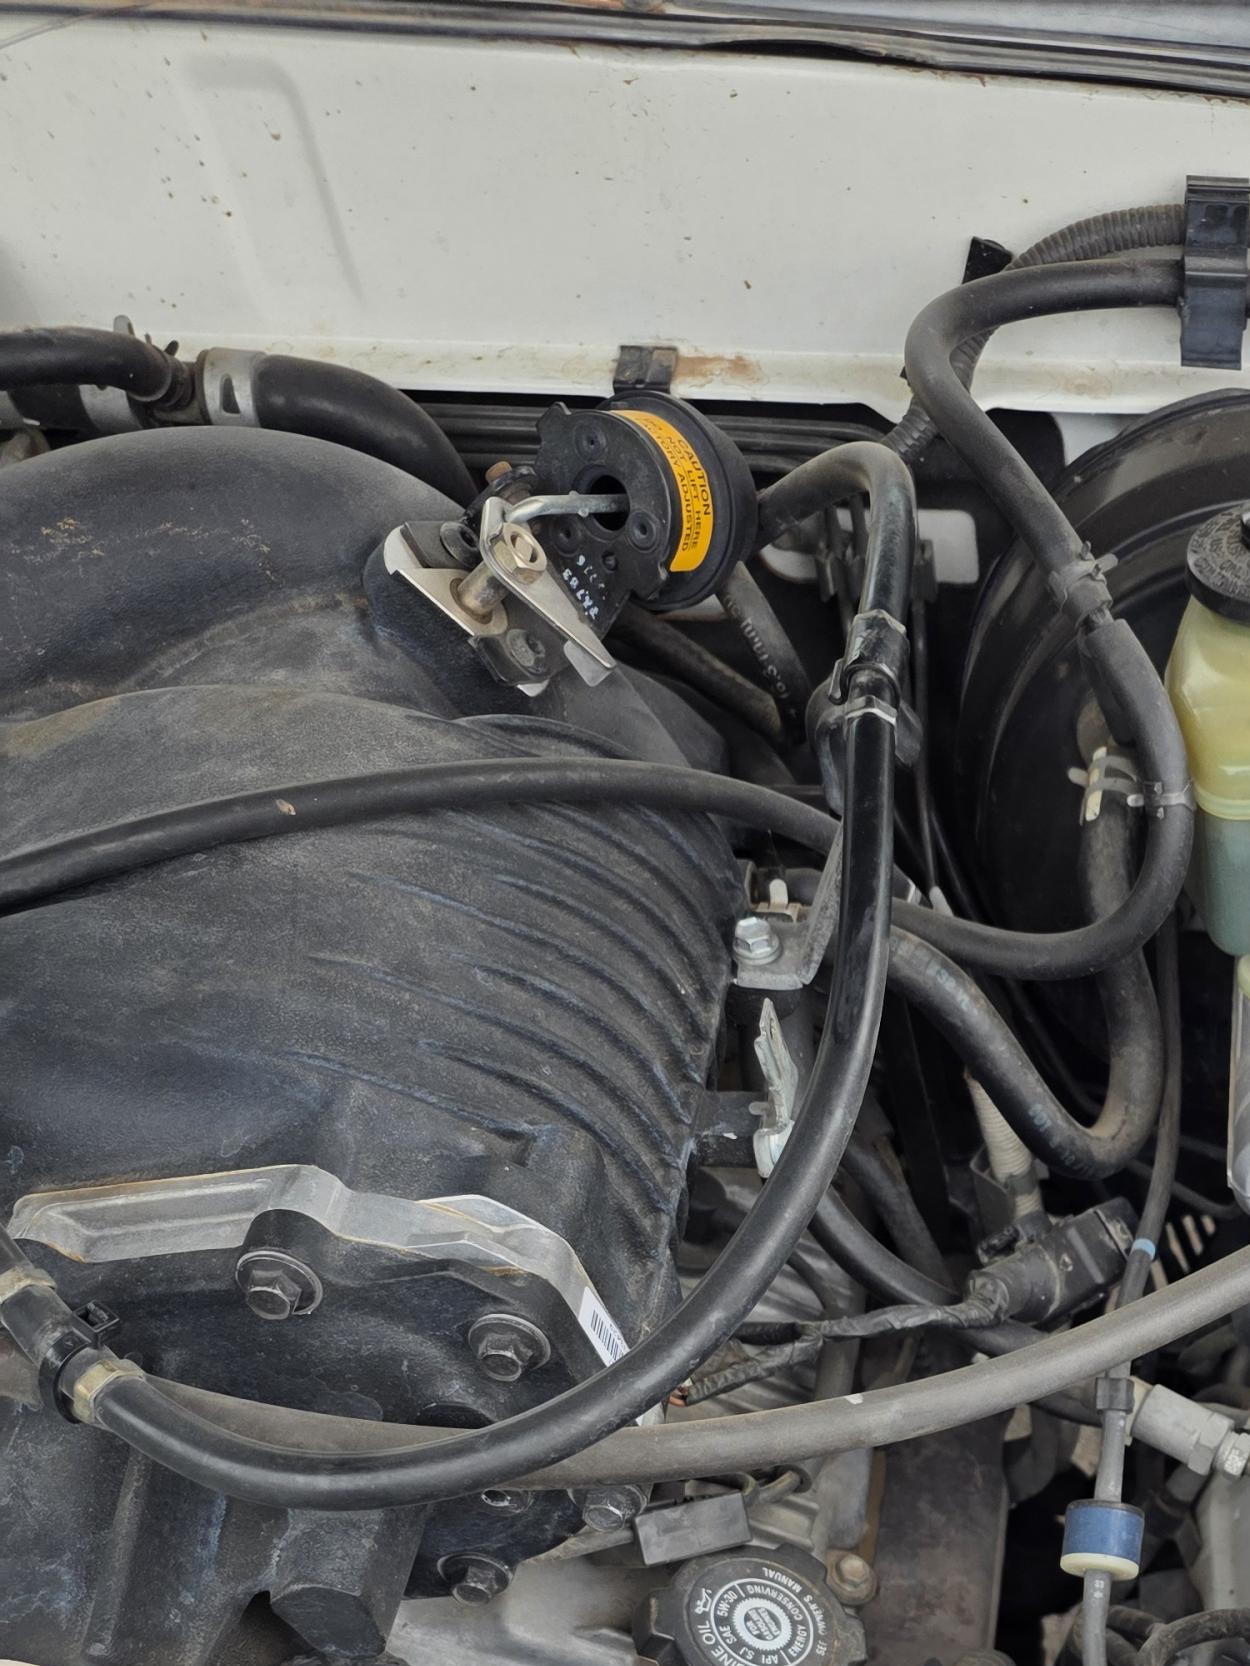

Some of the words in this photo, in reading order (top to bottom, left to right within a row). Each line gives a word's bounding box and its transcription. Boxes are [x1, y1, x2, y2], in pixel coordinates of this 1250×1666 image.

[678, 439, 711, 516] CAUTION
[687, 470, 700, 499] LIFT
[678, 473, 693, 551] ADJUSTED
[691, 510, 701, 550] HERE
[762, 1567, 803, 1593] MANUAL
[717, 1590, 738, 1617] 5W-30
[745, 1584, 803, 1621] CONSERVING
[697, 1620, 716, 1645] OIL
[719, 1624, 738, 1645] SAE
[788, 1624, 808, 1657] ENERGY
[739, 1646, 756, 1660] SJ
[761, 1654, 779, 1664] API
